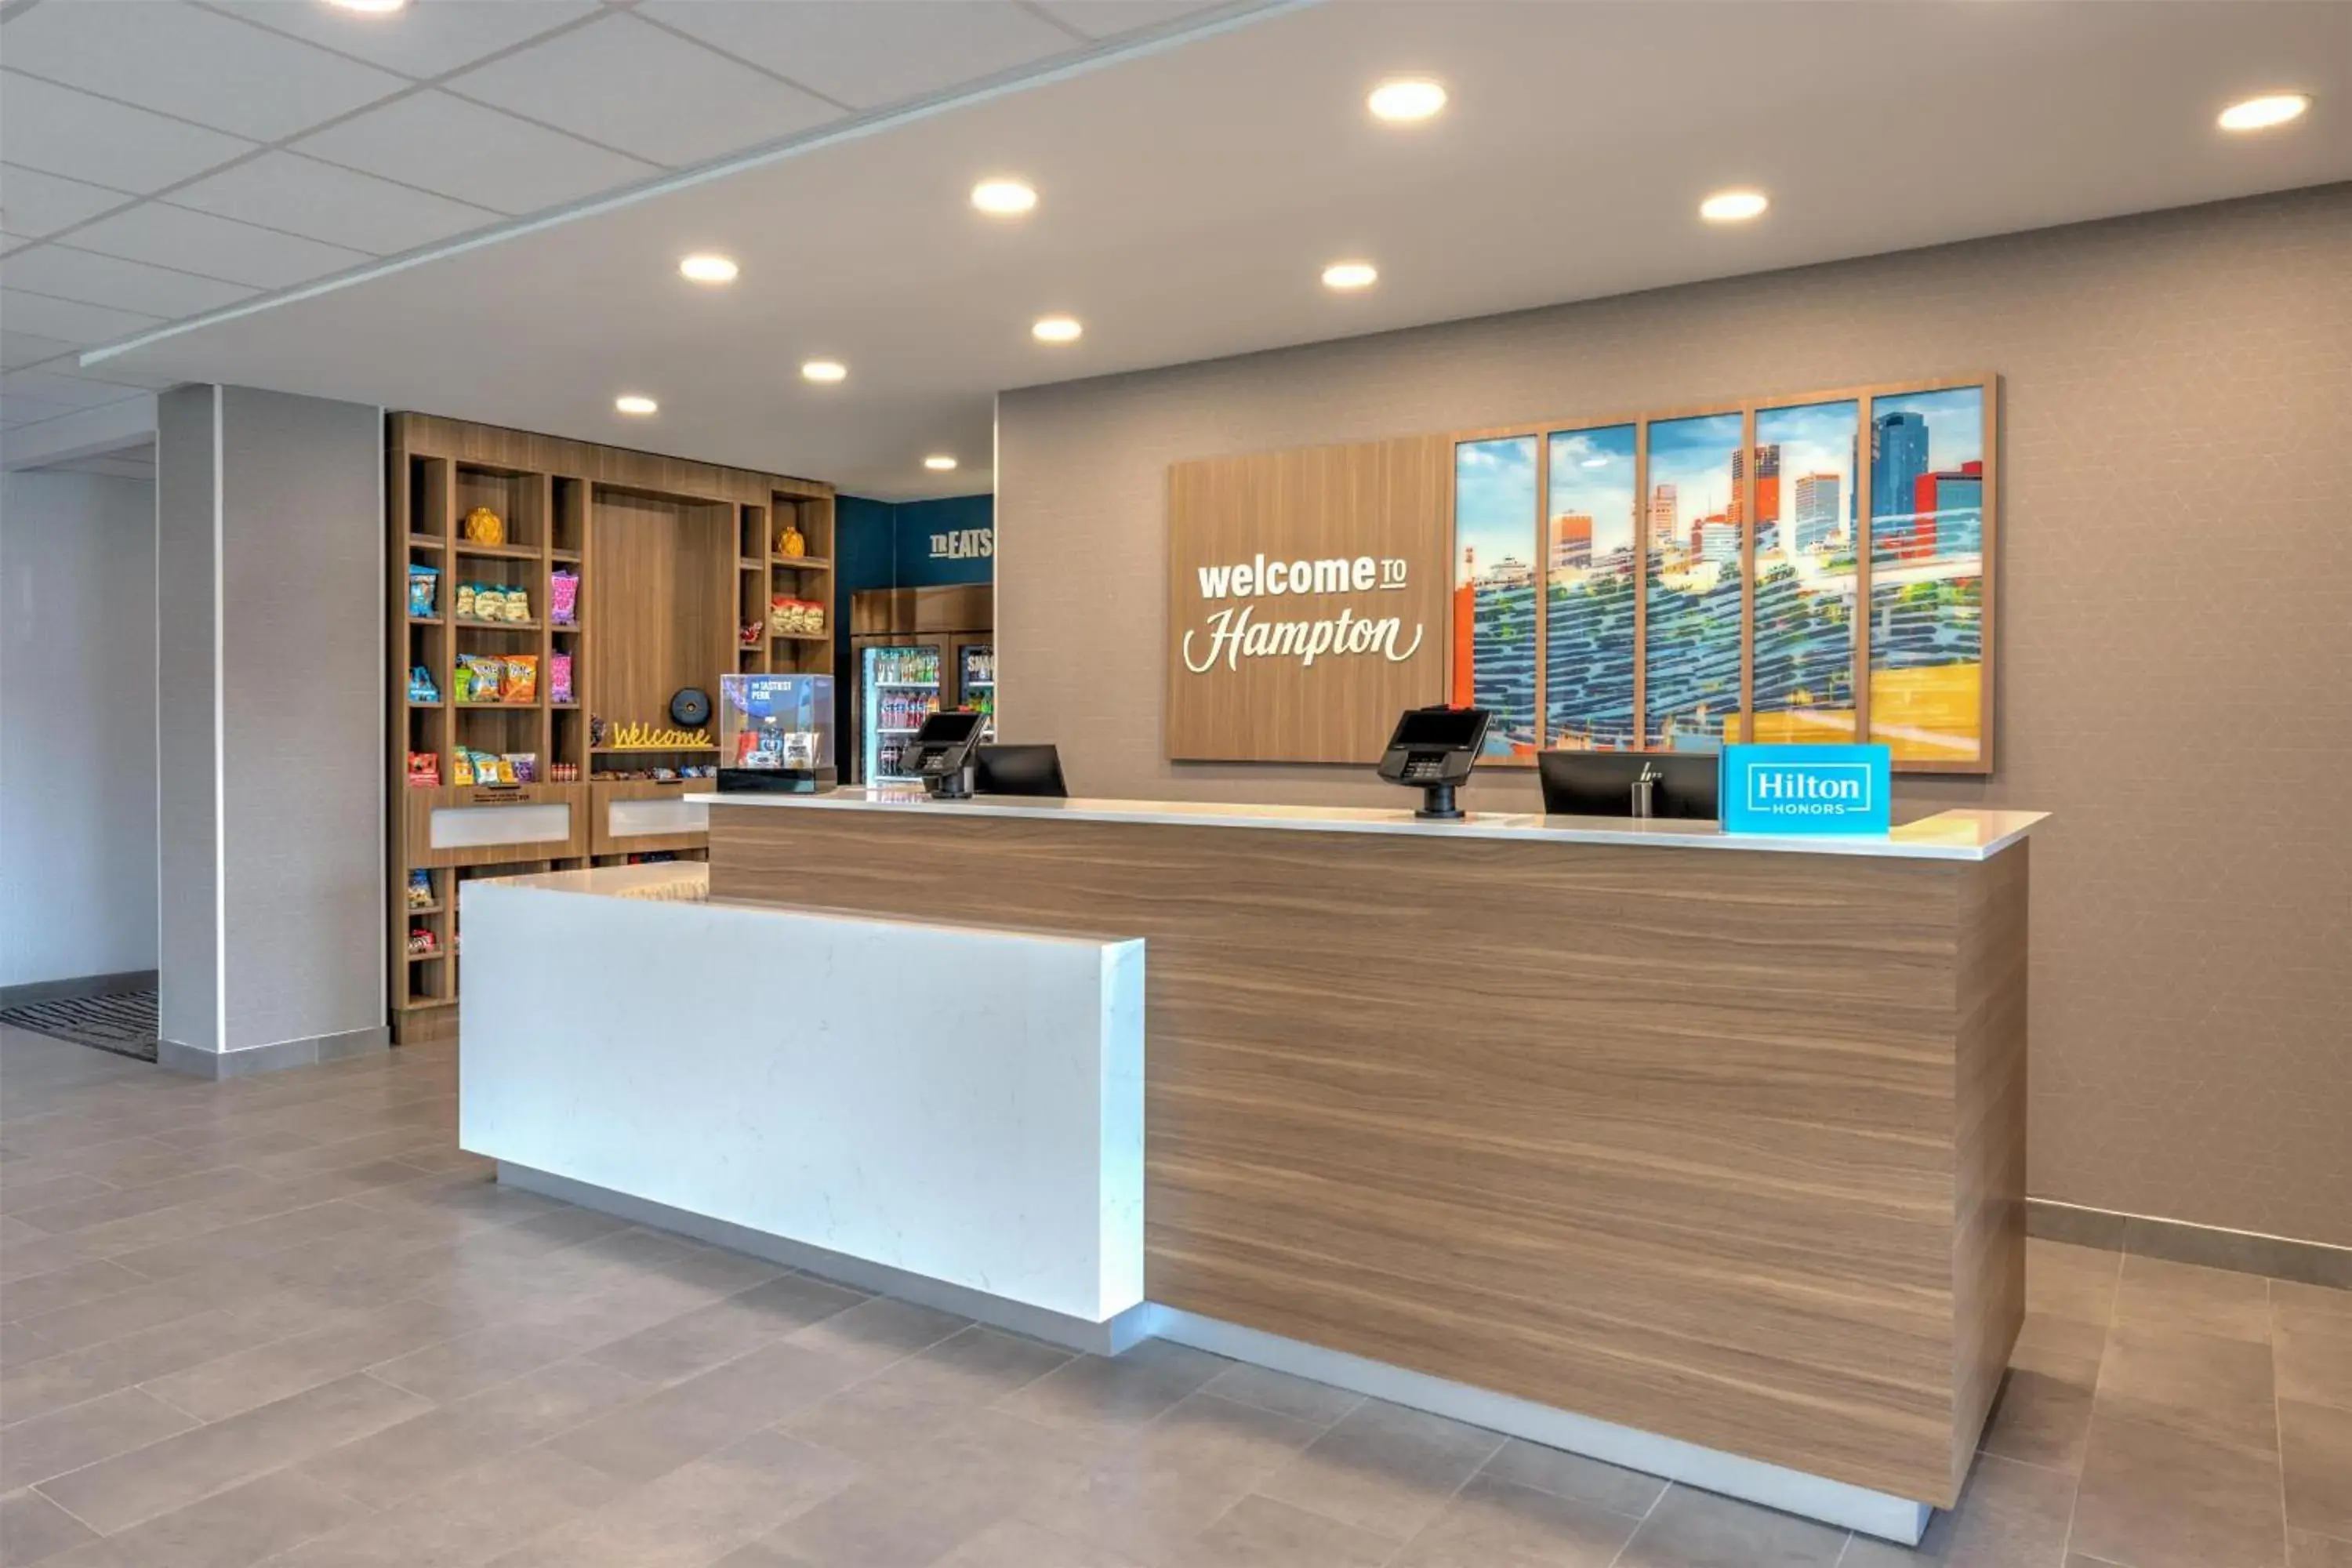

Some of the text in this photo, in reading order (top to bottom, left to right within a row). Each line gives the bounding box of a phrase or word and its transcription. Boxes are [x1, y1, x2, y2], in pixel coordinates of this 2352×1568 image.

[1198, 554, 1407, 598] welcome TO
[1183, 604, 1423, 673] Hampton
[613, 720, 712, 746] Welcome
[1759, 773, 1860, 800] Hilton
[1773, 804, 1846, 815] HONORS
